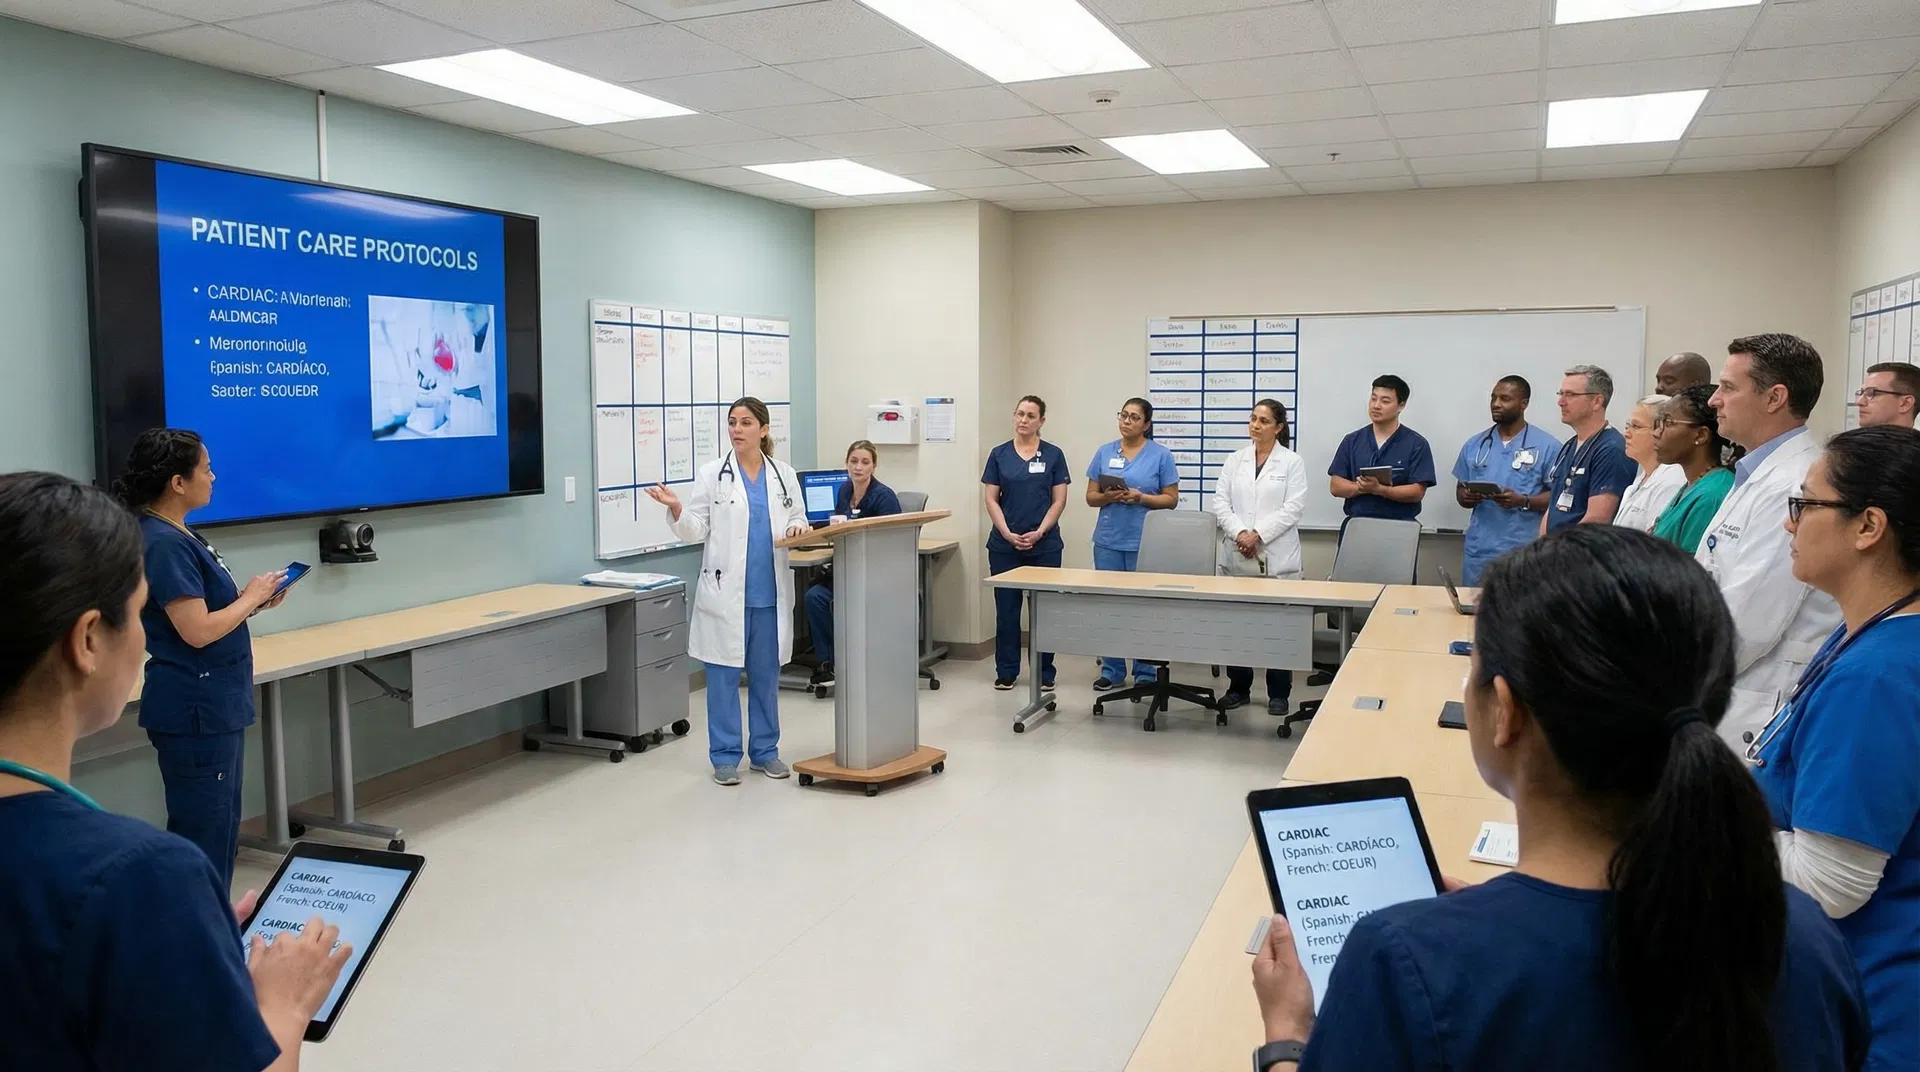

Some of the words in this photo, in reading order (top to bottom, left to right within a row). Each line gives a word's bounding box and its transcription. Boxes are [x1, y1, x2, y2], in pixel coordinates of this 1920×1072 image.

[191, 217, 291, 251] PATIENT
[297, 230, 358, 258] CARE
[363, 238, 478, 271] PROTOCOLS
[207, 284, 279, 303] CARDIAC:
[266, 360, 330, 377] CARDÍACO,
[1278, 827, 1330, 841] CARDIAC
[1282, 844, 1335, 860] (Spanish:
[1336, 836, 1400, 853] CARDÍACO,
[1286, 859, 1330, 876] French:
[1332, 856, 1377, 871] COEUR)
[291, 872, 333, 884] CARDIAC
[1296, 895, 1350, 910] CARDIAC
[261, 918, 305, 932] CARDIAC
[1301, 913, 1355, 931] (Spanish:
